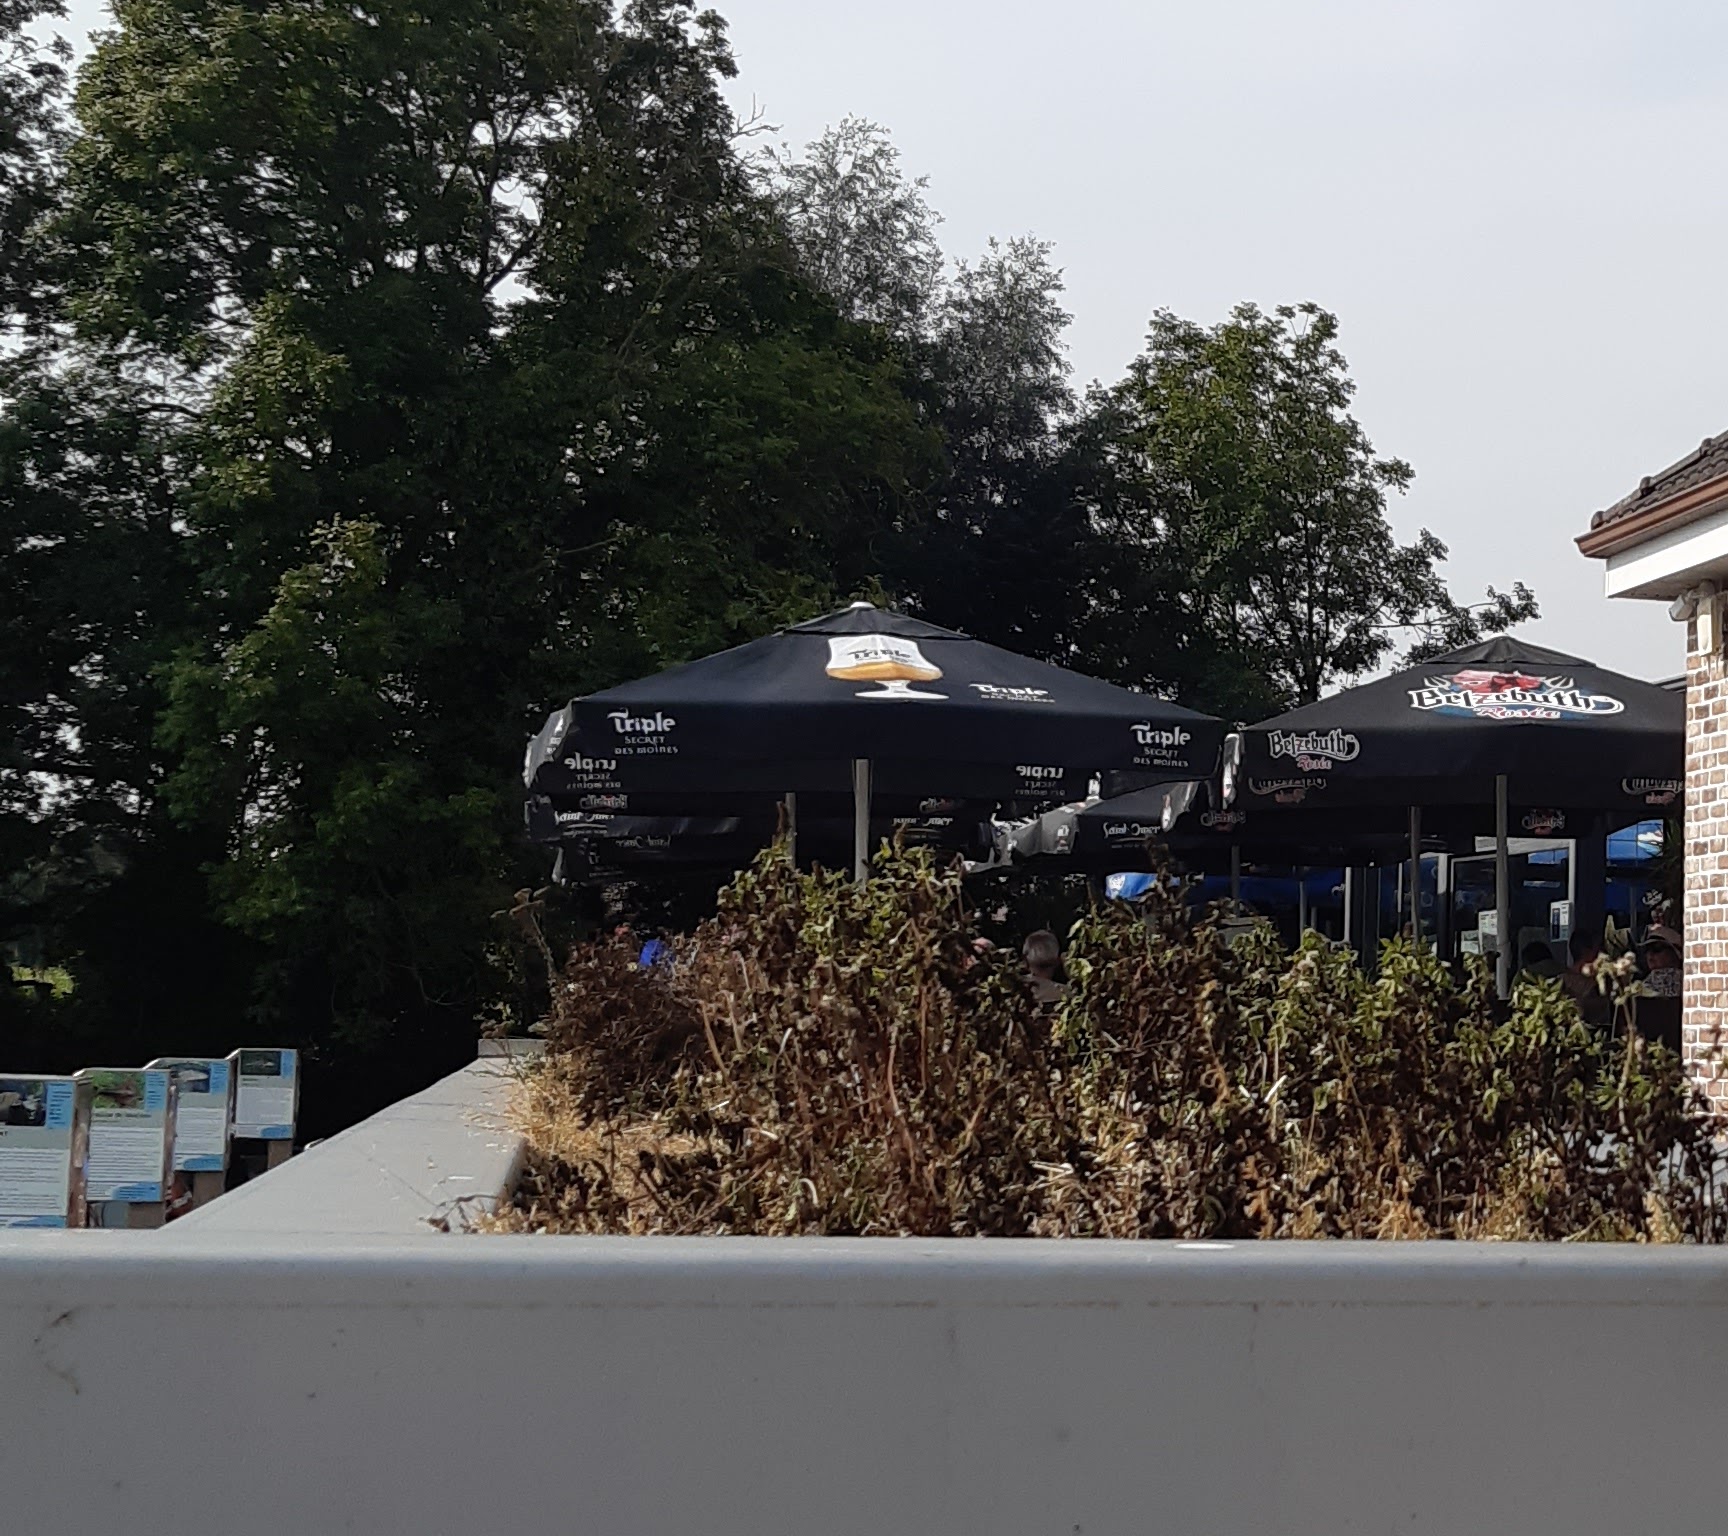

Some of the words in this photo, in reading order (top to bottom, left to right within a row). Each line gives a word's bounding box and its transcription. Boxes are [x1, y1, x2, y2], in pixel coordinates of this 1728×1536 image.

[1407, 686, 1625, 714] Belzebuth
[607, 707, 676, 734] Triple
[1129, 719, 1191, 748] Triple
[614, 747, 634, 755] DES
[624, 735, 666, 744] SECRET
[1143, 746, 1180, 759] SECRET
[1267, 728, 1360, 761] Belzebuth
